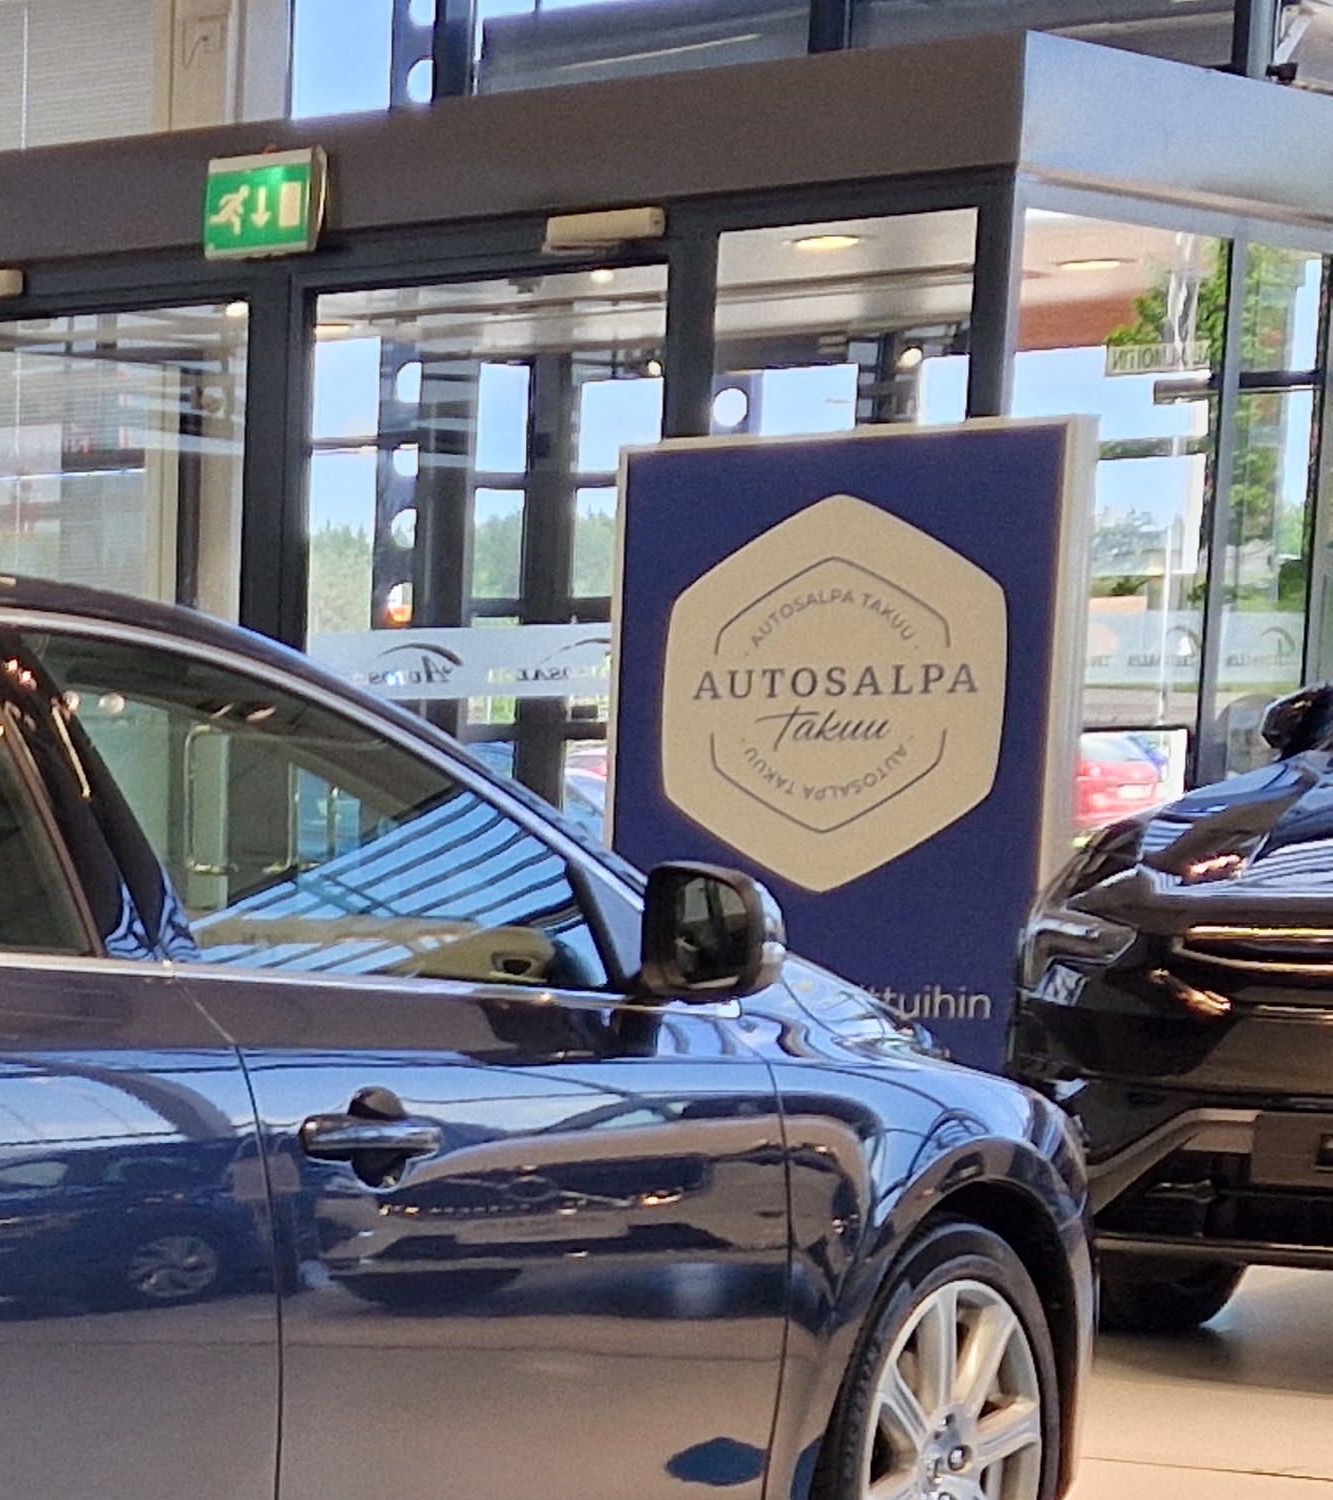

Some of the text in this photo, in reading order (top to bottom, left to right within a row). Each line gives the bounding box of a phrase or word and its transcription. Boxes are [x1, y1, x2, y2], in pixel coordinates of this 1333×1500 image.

[751, 588, 915, 648] AUTOSALPA TAKUU
[693, 663, 979, 700] AUTOSALPA
[755, 705, 890, 752] Takuu
[744, 744, 907, 800] AUTOSALPA TAKUU
